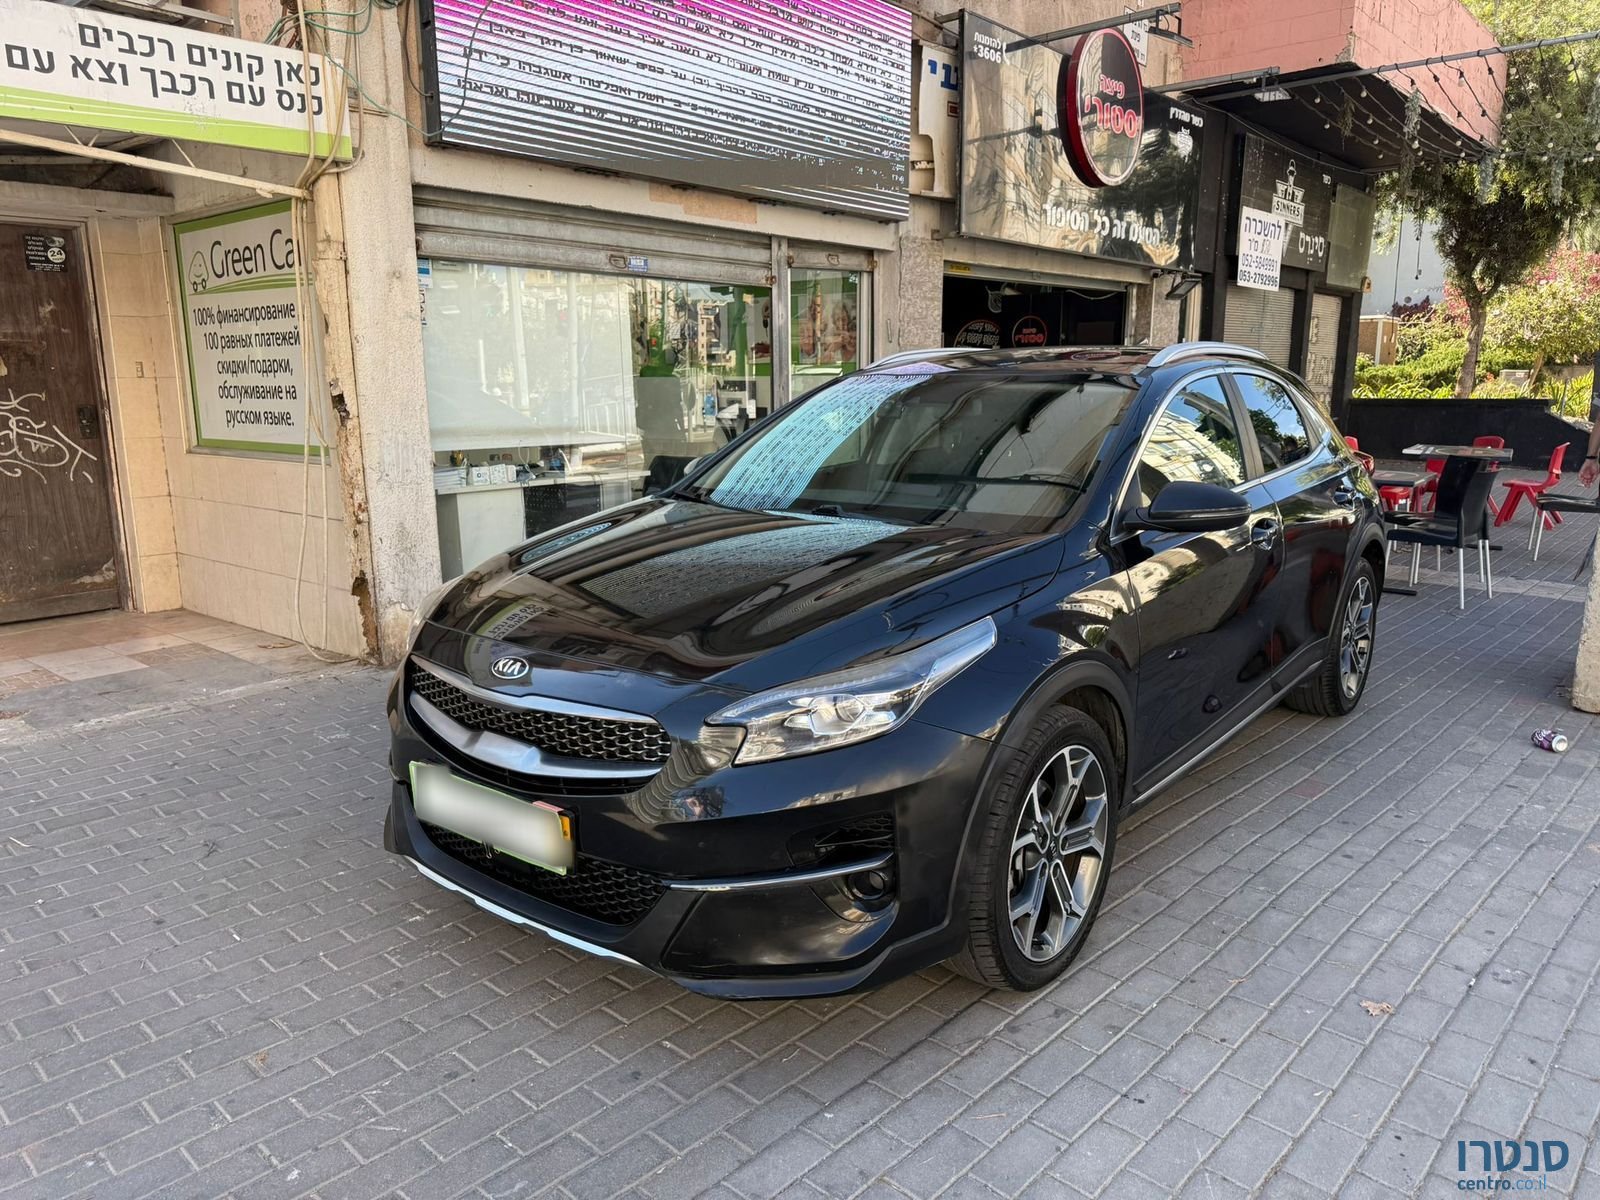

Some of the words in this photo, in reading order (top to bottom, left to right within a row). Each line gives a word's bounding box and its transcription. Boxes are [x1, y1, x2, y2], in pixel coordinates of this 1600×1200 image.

[78, 23, 174, 62] רכבים
[974, 32, 1001, 49] להזמנות
[5, 43, 55, 73] עם
[70, 55, 129, 86] וצא
[187, 44, 264, 82] קונים
[141, 66, 215, 99] רכבך
[275, 59, 320, 87] כאן
[1099, 74, 1125, 99] פיצה
[226, 80, 265, 107] עם
[276, 88, 323, 116] כנס
[1084, 94, 1138, 138] סטורי
[1042, 203, 1089, 232] הסיפור
[1275, 200, 1300, 217] SINNERS
[1094, 209, 1110, 236] כל
[1112, 219, 1127, 240] זה
[1244, 215, 1282, 241] להשכרה
[49, 250, 63, 258] 24
[210, 240, 266, 279] Green
[1238, 268, 1279, 288] 053-2792996
[193, 307, 215, 327] 100%
[216, 301, 295, 329] финансирование
[204, 332, 219, 351] 100
[220, 334, 253, 353] равных
[254, 326, 300, 349] платежей
[216, 355, 293, 378] скидки/подарки,
[218, 382, 283, 405] обслуживание
[284, 387, 297, 400] на
[225, 408, 262, 428] русском
[263, 410, 295, 427] языке.
[494, 658, 522, 675] KIA
